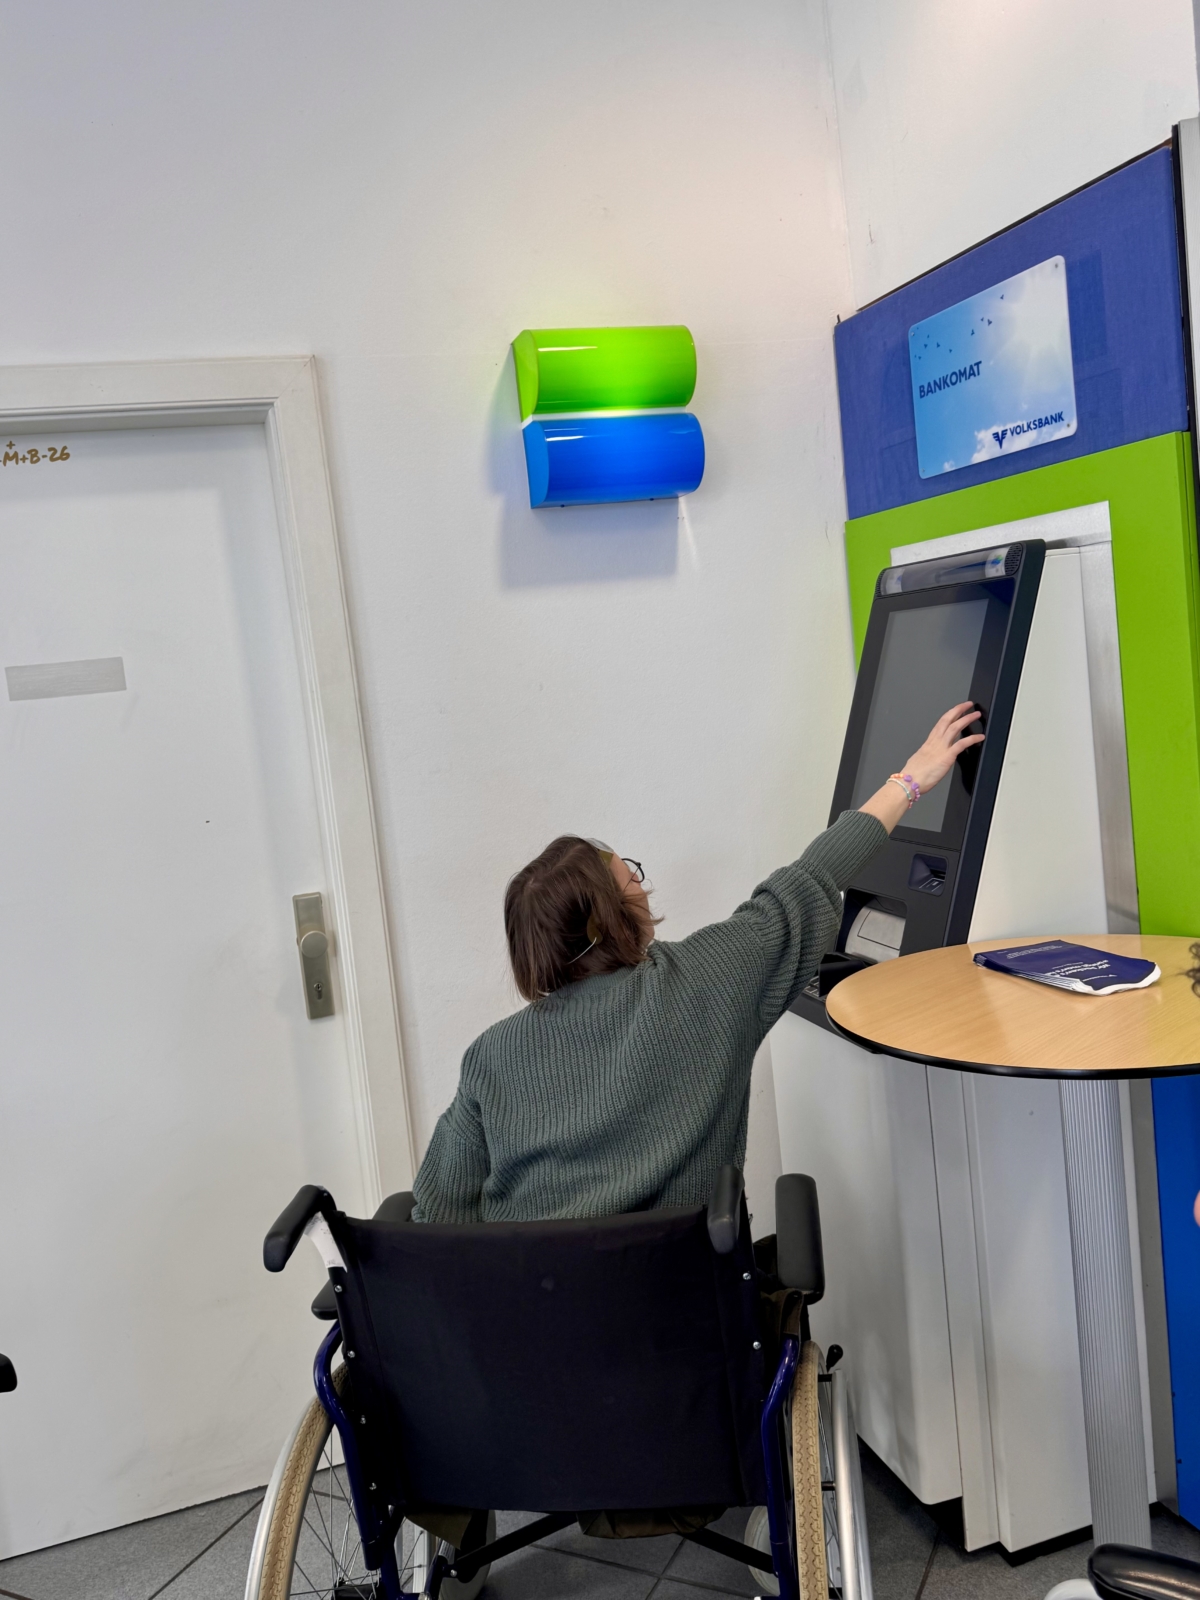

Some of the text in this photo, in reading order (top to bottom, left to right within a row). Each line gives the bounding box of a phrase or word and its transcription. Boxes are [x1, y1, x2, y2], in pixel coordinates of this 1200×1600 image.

[919, 360, 982, 399] BANKOMAT
[1009, 411, 1065, 437] VOLKSBANK
[0, 445, 71, 467] M+B-26
